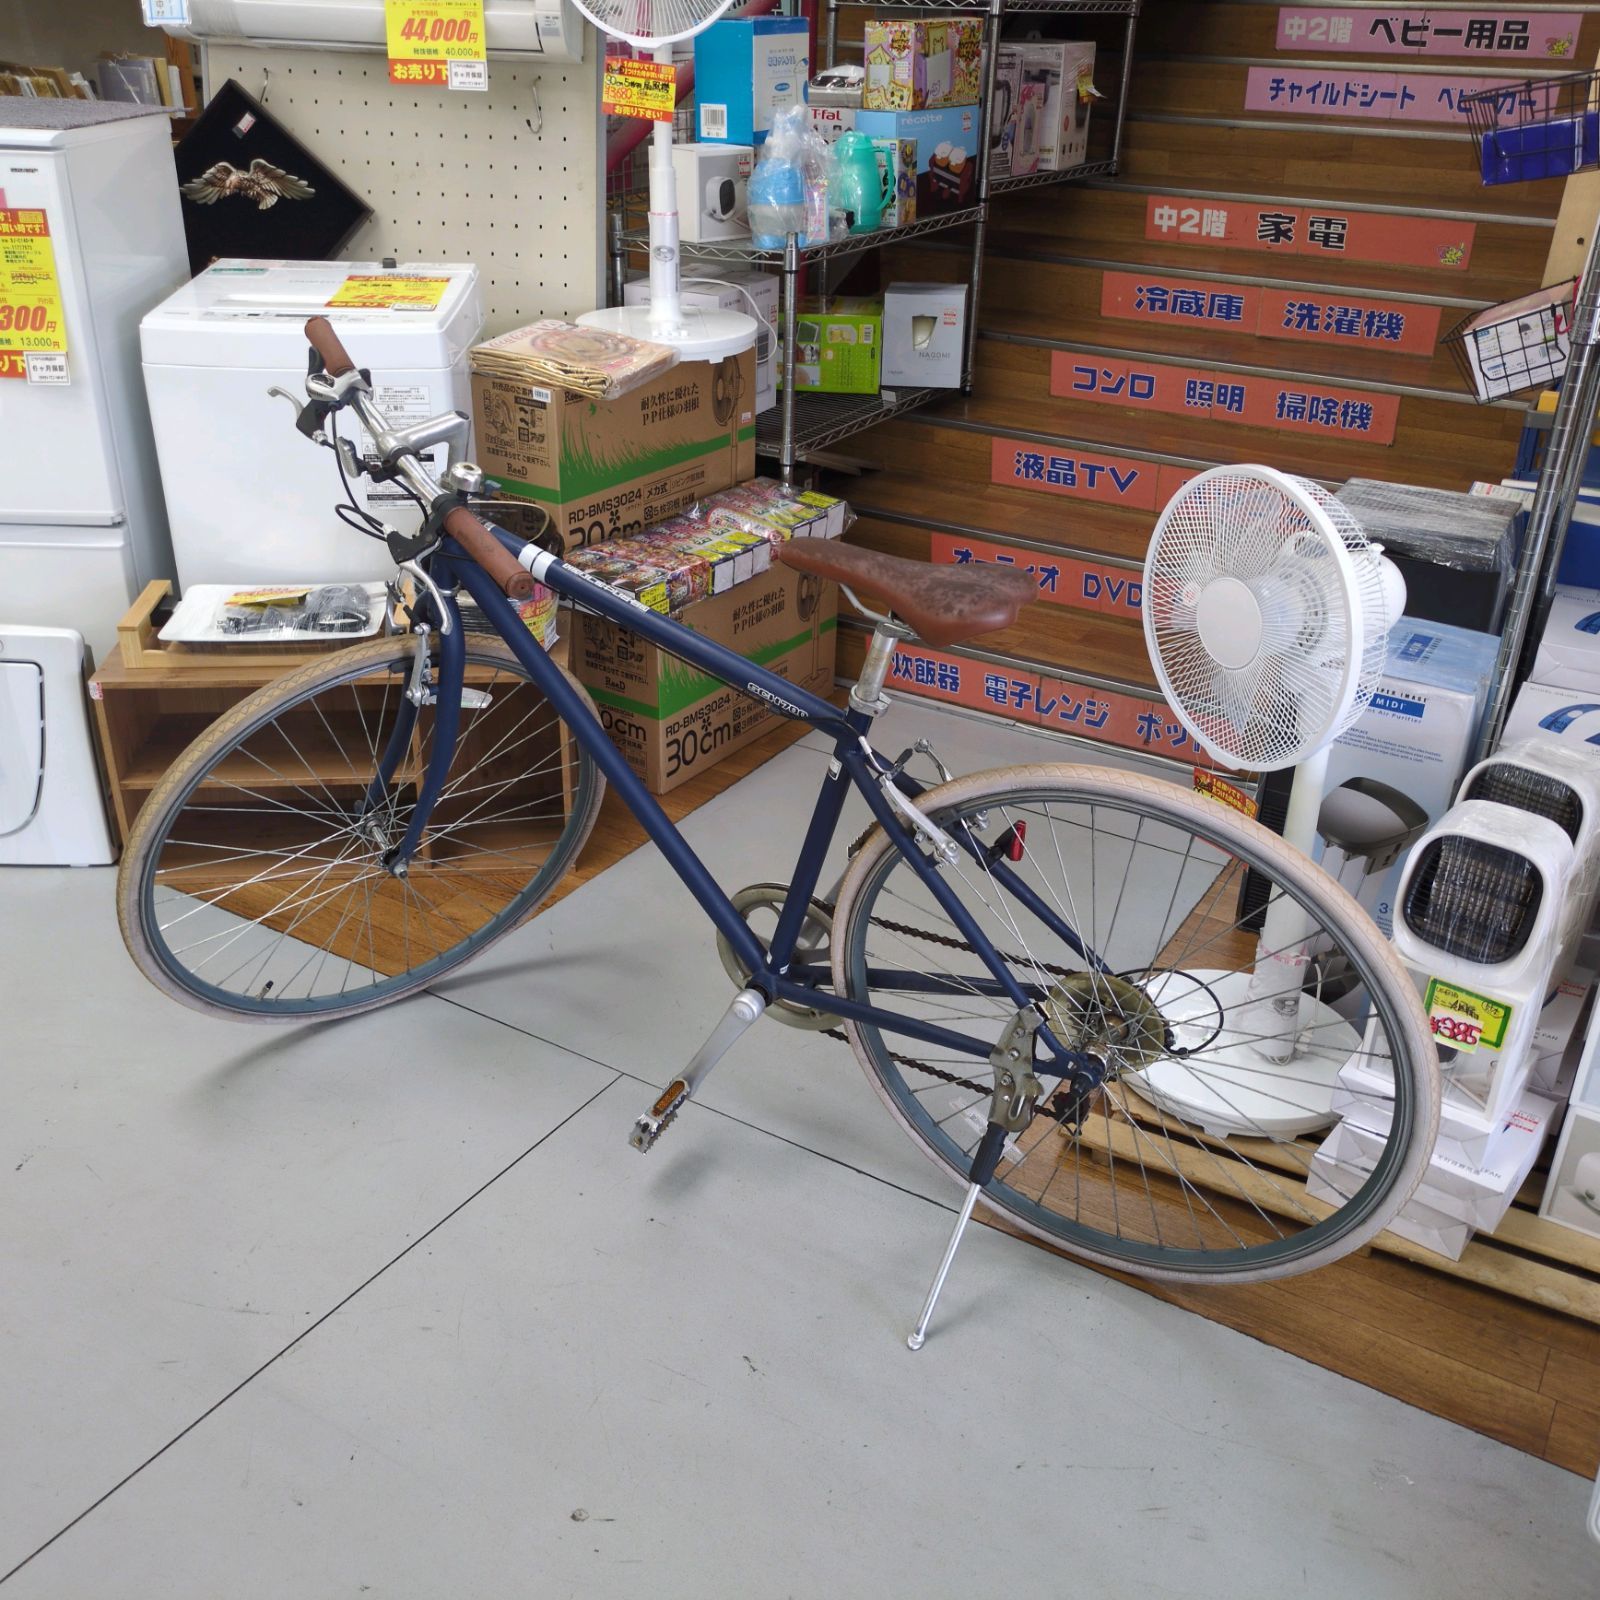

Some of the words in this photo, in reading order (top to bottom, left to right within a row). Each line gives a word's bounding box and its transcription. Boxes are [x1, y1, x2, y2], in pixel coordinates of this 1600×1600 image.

[400, 18, 478, 43] 44,000円
[1285, 16, 1353, 43] 中2階
[1369, 17, 1530, 51] ベビー用品
[1268, 78, 1416, 109] チャイルドシート
[811, 109, 842, 121] T-fal
[901, 113, 943, 126] récolte
[1153, 205, 1228, 238] 中2階
[1257, 213, 1348, 250] 家電
[1135, 286, 1245, 322] 冷蔵庫
[1282, 301, 1405, 341] 洗濯機
[641, 382, 699, 411] 耐久性に優れた
[1072, 365, 1156, 400] コンロ
[1185, 379, 1246, 413] 照明
[1275, 391, 1373, 432] 掃除機
[507, 462, 528, 476] ReeD
[1014, 450, 1139, 494] 液晶TV
[567, 487, 642, 525] RD-BMS3024
[646, 482, 668, 499] メカ式
[733, 587, 785, 622] 耐久性に優れた
[1083, 572, 1143, 608] DVD
[891, 651, 961, 694] 炊飯器
[983, 673, 1110, 729] 電子レンジ
[1375, 698, 1404, 710] MIDI
[600, 709, 647, 742] 0cm
[665, 693, 731, 738] RD-BMS3024
[666, 722, 731, 778] 30cm
